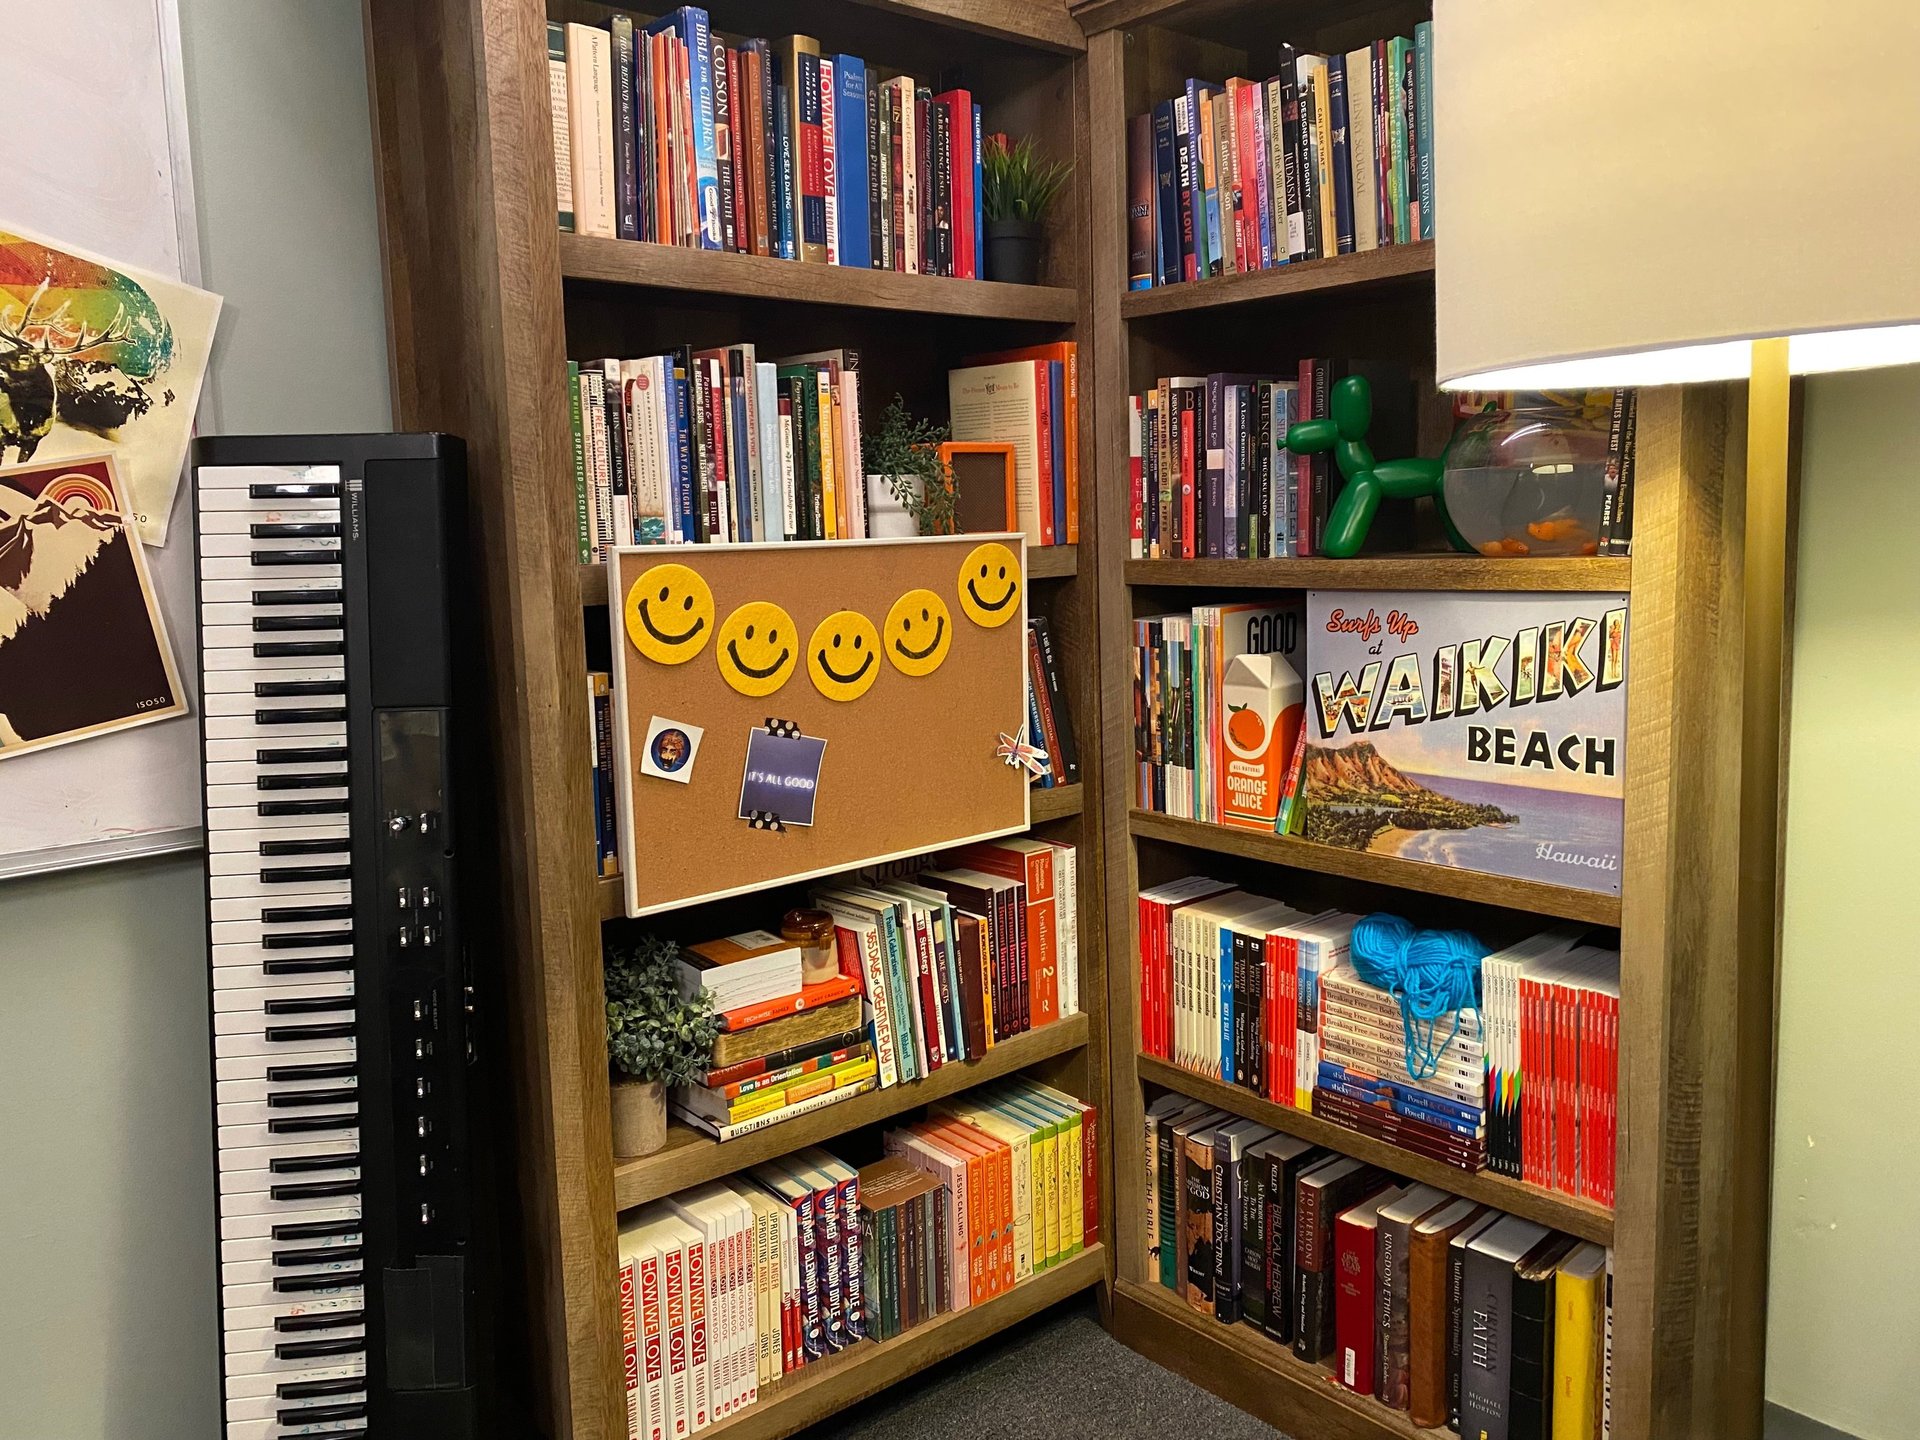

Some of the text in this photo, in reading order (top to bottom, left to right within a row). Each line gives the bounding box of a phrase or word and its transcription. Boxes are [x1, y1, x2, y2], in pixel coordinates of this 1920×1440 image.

[695, 23, 708, 62] BIBLE
[700, 86, 713, 151] CHILDREN
[713, 44, 732, 219] COLSON THE FAITH
[1221, 140, 1229, 174] father,
[1272, 106, 1280, 141] Bondage
[1277, 196, 1285, 224] Luther
[1421, 153, 1429, 180] TONY
[1180, 147, 1192, 243] DEATH BY LOVE
[1284, 152, 1296, 206] JUDAISM
[1303, 162, 1311, 198] DIGNITY
[826, 200, 834, 244] YERKOVICH
[1305, 208, 1313, 238] PRATT
[703, 377, 712, 408] Passion
[706, 411, 712, 419] &
[1261, 392, 1270, 449] SILENCE
[595, 409, 606, 485] FREE CULTURE
[680, 446, 688, 462] WAY
[823, 402, 832, 493] Managing People
[575, 432, 588, 542] SURPRISED SCRIPTURE
[681, 466, 688, 475] OF
[700, 458, 708, 492] TESTAMENT
[351, 492, 359, 538] WILLIAMS
[682, 484, 690, 515] PILGRIM
[1247, 612, 1298, 654] GOOD
[1326, 608, 1419, 643] Surfs Up
[1369, 639, 1383, 655] at
[1312, 608, 1627, 739] WAIKIKI
[135, 696, 167, 710] ISO50
[1029, 690, 1041, 733] MEMBERSHIP
[1243, 765, 1261, 773] NATURAL
[1467, 724, 1617, 777] BEACH
[748, 771, 814, 790] IT'S ALL GOOD
[1226, 775, 1268, 796] ORANGE
[1232, 791, 1263, 811] JUICE
[1535, 842, 1618, 871] Hawaii
[866, 928, 877, 948] 365
[919, 937, 929, 976] Strategy
[1039, 908, 1054, 978] Aesthetics 2
[868, 950, 881, 979] DAYS
[885, 916, 910, 1060] Family Celebrations Hibbard
[1324, 980, 1350, 993] Breaking
[1351, 986, 1364, 998] Free
[1376, 994, 1395, 1005] Body
[873, 986, 889, 1034] CREATIVE
[878, 1035, 892, 1065] PLAY
[739, 1082, 754, 1092] Love
[755, 1080, 761, 1088] Is
[771, 1067, 803, 1083] Orientation
[1332, 1071, 1351, 1081] sticky
[1407, 1095, 1428, 1106] Powell
[730, 1118, 771, 1137] QUESTIONS
[803, 1101, 827, 1112] ANSWERS
[834, 1091, 852, 1101] OLSON
[1144, 1121, 1153, 1178] WALKING
[1190, 1187, 1210, 1200] GOD
[1214, 1164, 1224, 1276] CHRISTIAN DOCTRINE
[1305, 1192, 1314, 1267] TO EVERYONE
[801, 1201, 819, 1326] UNTAMED GLENNON DOYLE
[824, 1195, 841, 1319] UNTAMED GLENNON DOYLE
[845, 1185, 860, 1307] UNTAMED GLENNON DOYLE
[1272, 1203, 1282, 1319] BIBLICAL HEBREW
[1341, 1259, 1361, 1272] YEAR
[1342, 1252, 1359, 1263] ONE
[1383, 1232, 1392, 1288] KINGDOM
[758, 1216, 769, 1359] UPROOTING ANGER JONES
[1382, 1289, 1391, 1328] ETHICS
[1452, 1260, 1462, 1356] Authentic Spirituality
[1473, 1310, 1488, 1368] FAITH
[695, 1368, 705, 1409] YERKOVICH
[1468, 1391, 1501, 1410] MICHAEL
[1469, 1401, 1501, 1419] HORTON
